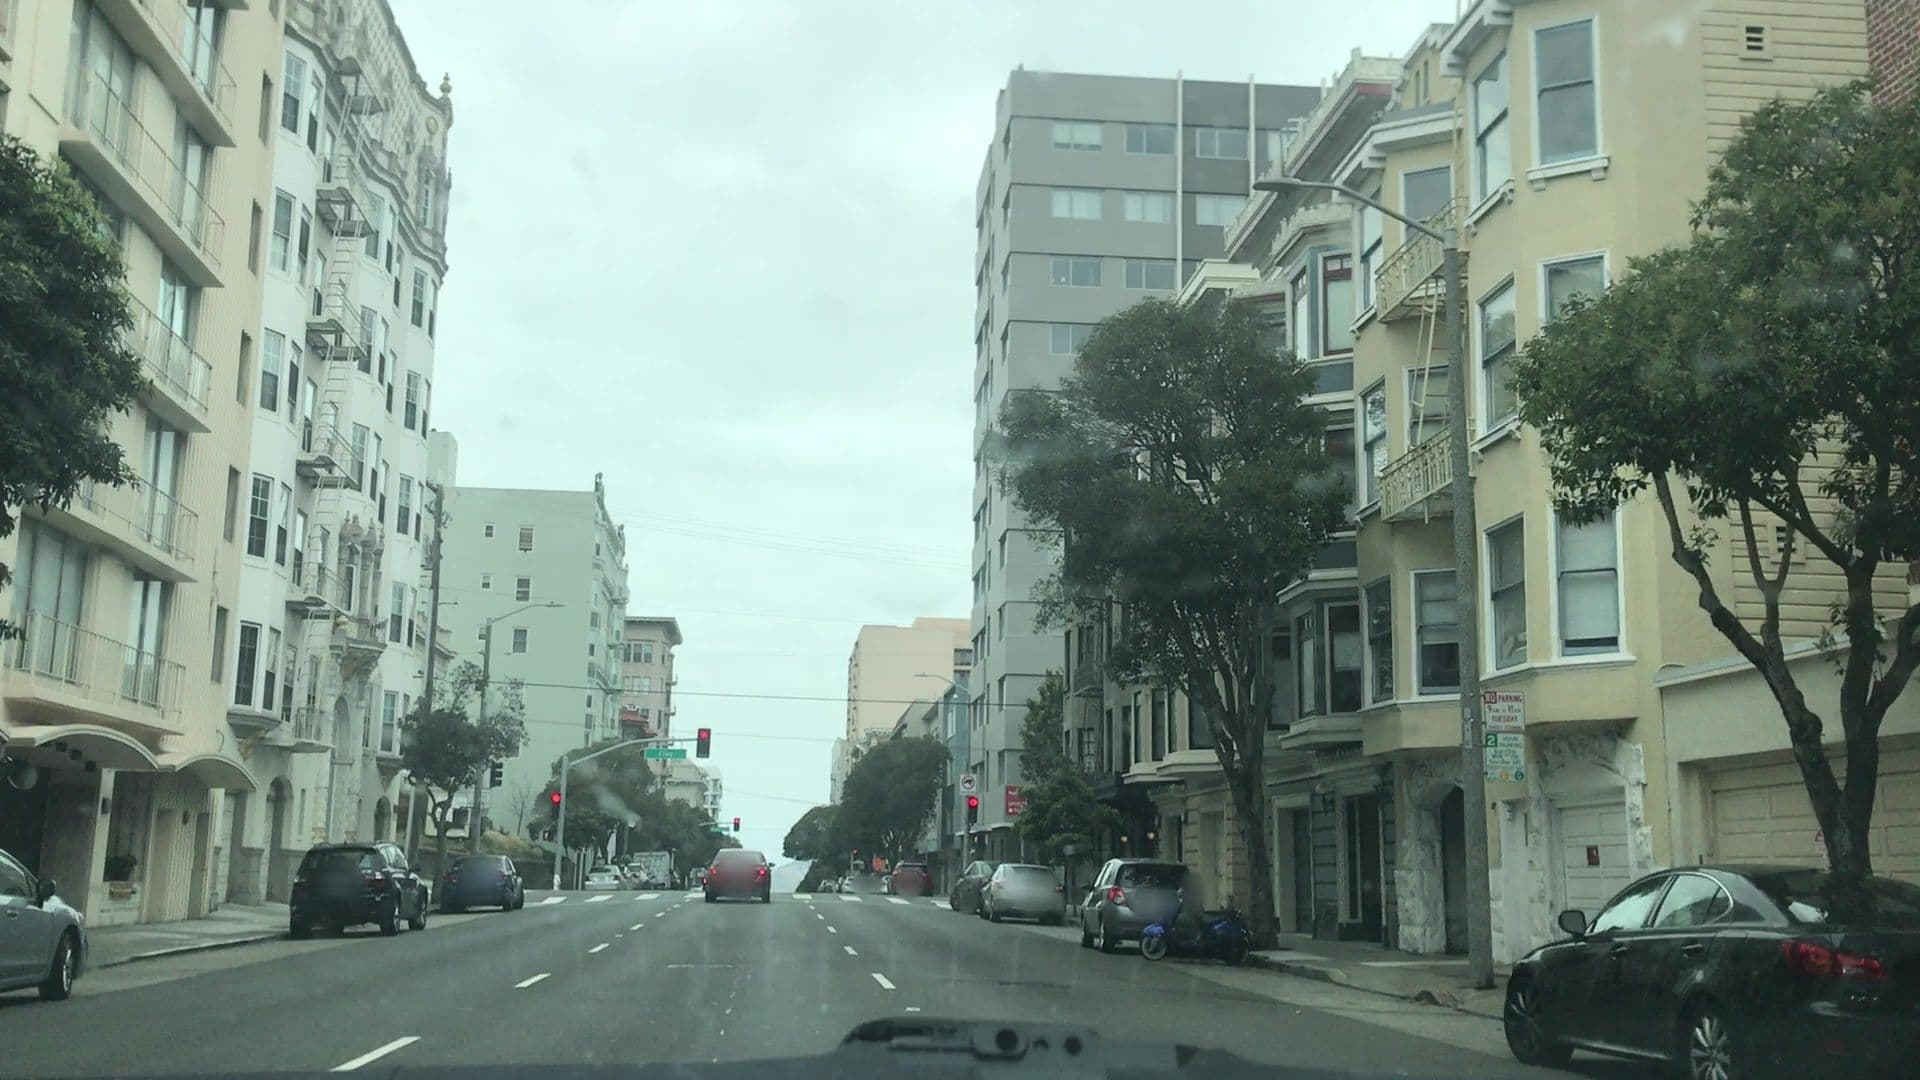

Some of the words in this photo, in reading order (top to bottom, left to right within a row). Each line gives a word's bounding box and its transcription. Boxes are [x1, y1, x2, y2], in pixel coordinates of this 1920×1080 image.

[1486, 692, 1496, 702] NO
[1498, 694, 1522, 703] PARKING
[1487, 735, 1496, 746] 2
